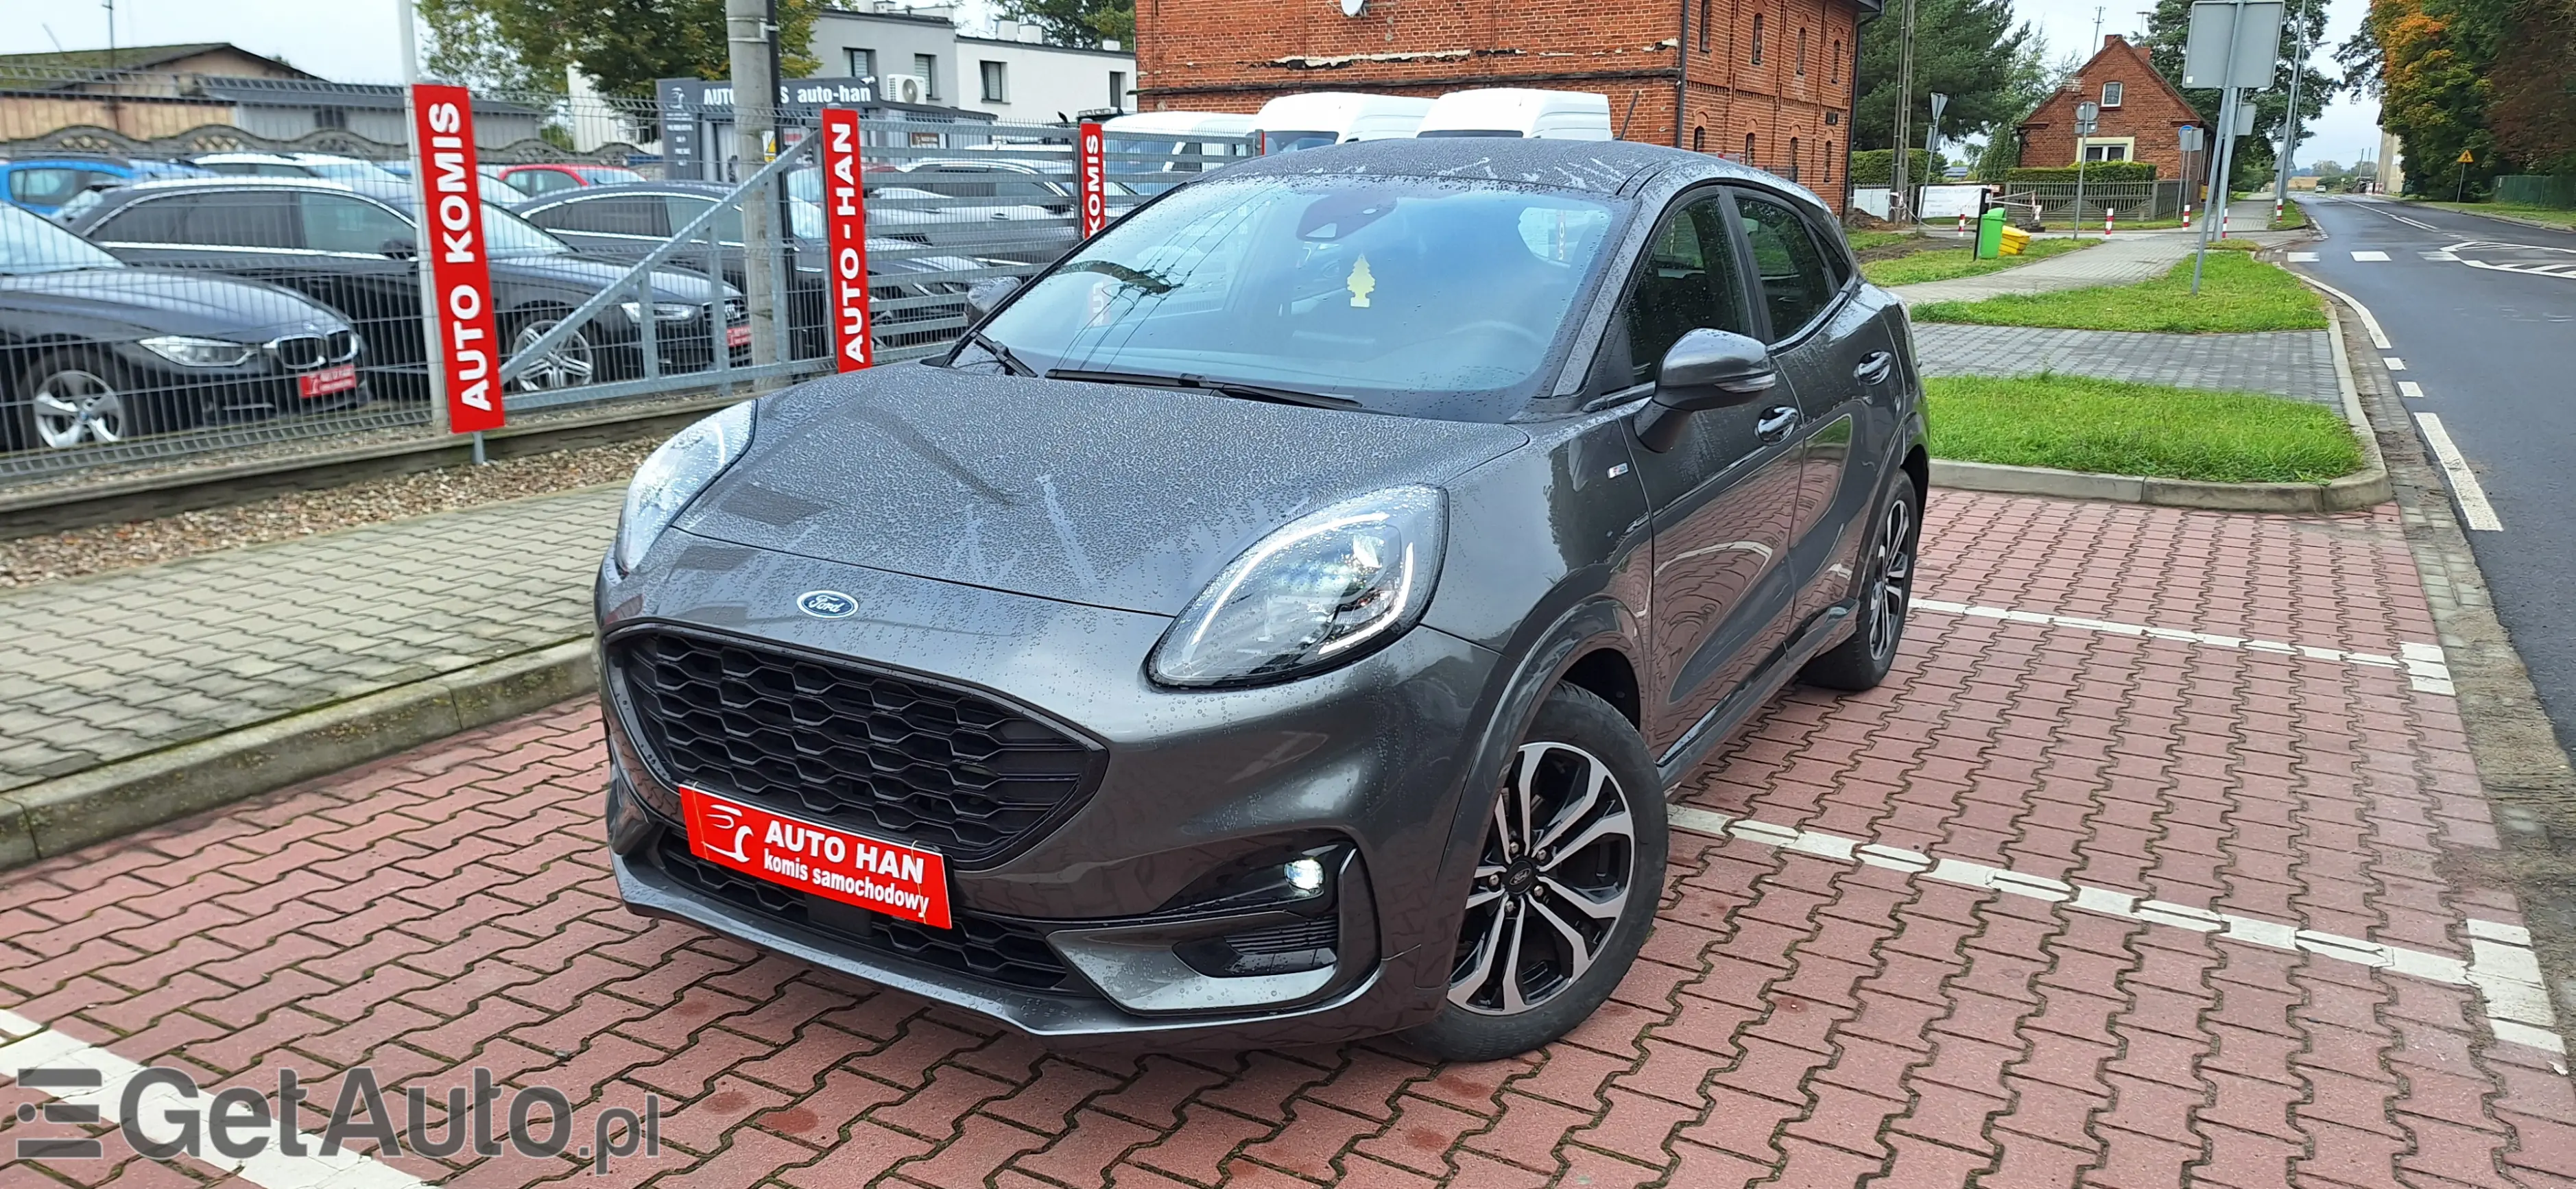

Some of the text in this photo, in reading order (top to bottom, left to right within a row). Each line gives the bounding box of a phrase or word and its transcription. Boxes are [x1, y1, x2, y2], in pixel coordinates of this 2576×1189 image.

[798, 85, 871, 103] auto-han
[1086, 134, 1101, 237] KOMIS
[429, 101, 492, 411] AUTO KOMIS
[809, 594, 845, 612] Ford
[764, 820, 924, 884] AUTO HAN
[764, 848, 929, 917] komis samochodowy
